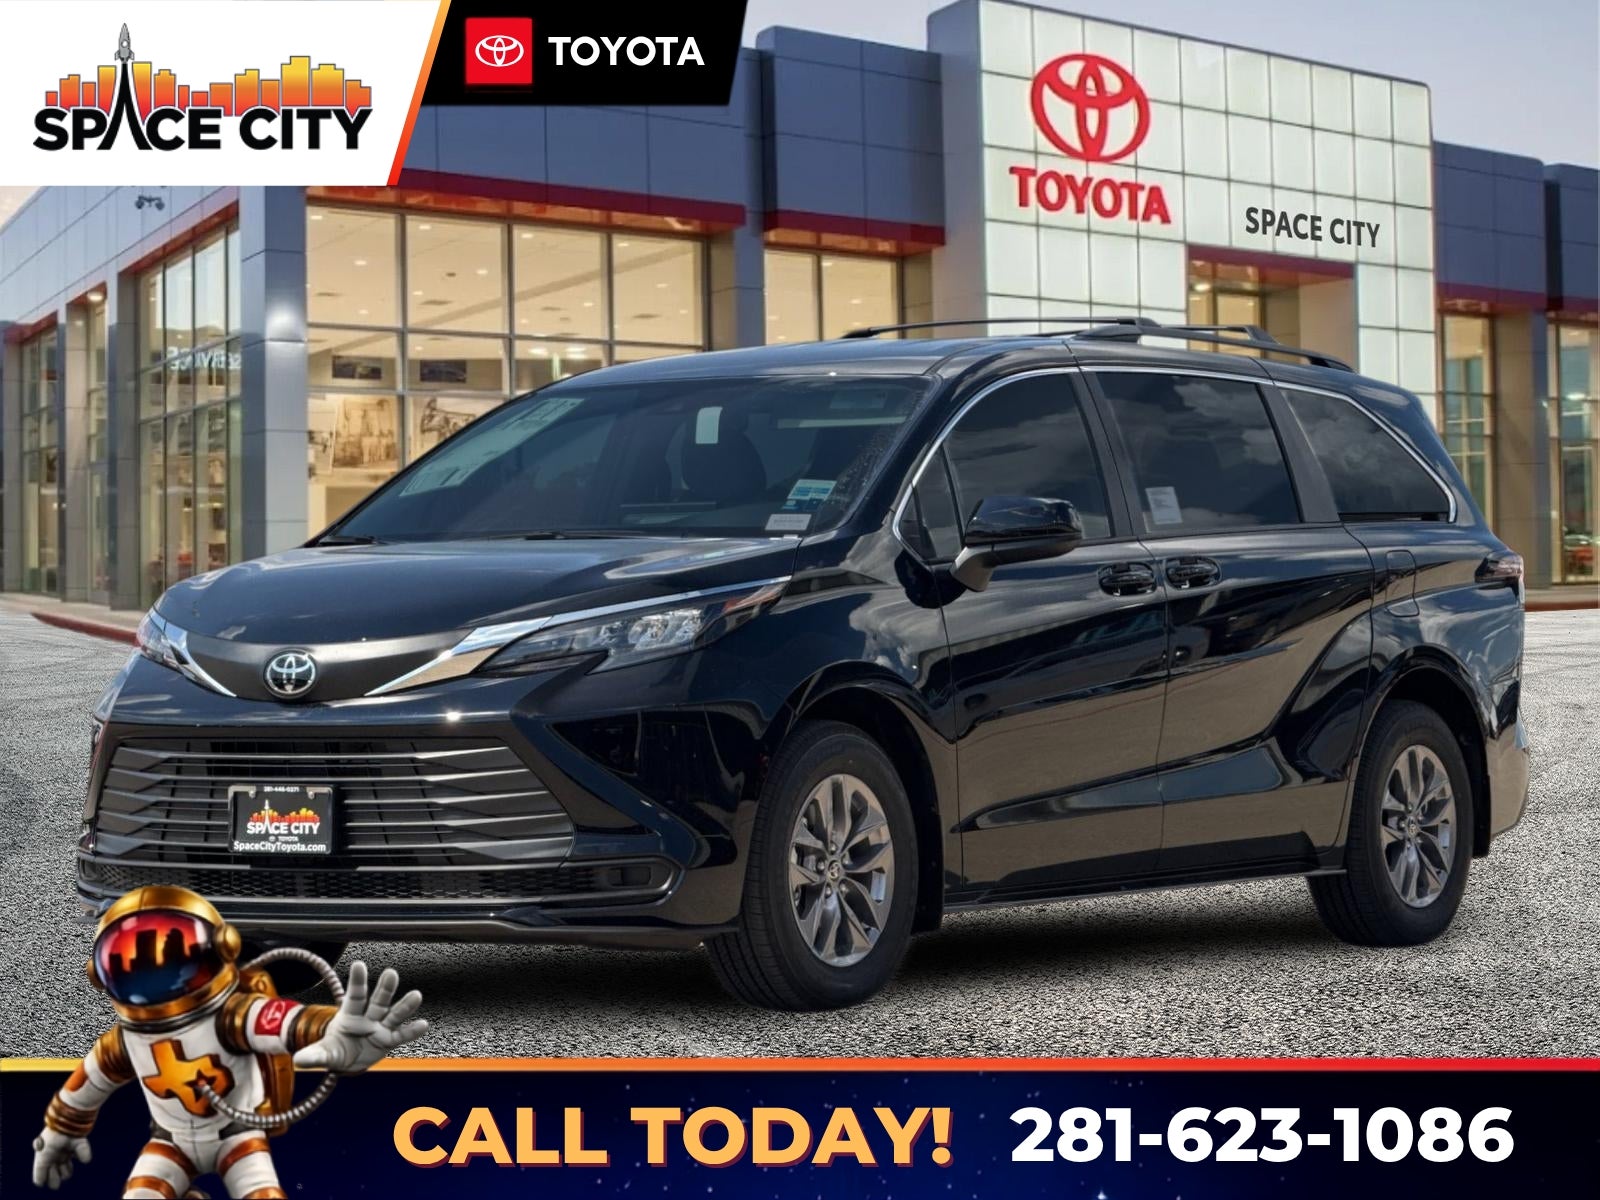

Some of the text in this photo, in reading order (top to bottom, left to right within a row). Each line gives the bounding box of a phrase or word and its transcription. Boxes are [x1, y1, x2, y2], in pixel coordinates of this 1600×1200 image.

[1009, 166, 1171, 224] TOYOTA
[1246, 206, 1381, 248] SPACE CITY
[247, 822, 320, 834] SPACE CITY
[233, 841, 326, 853] SpaceCityToyota.com
